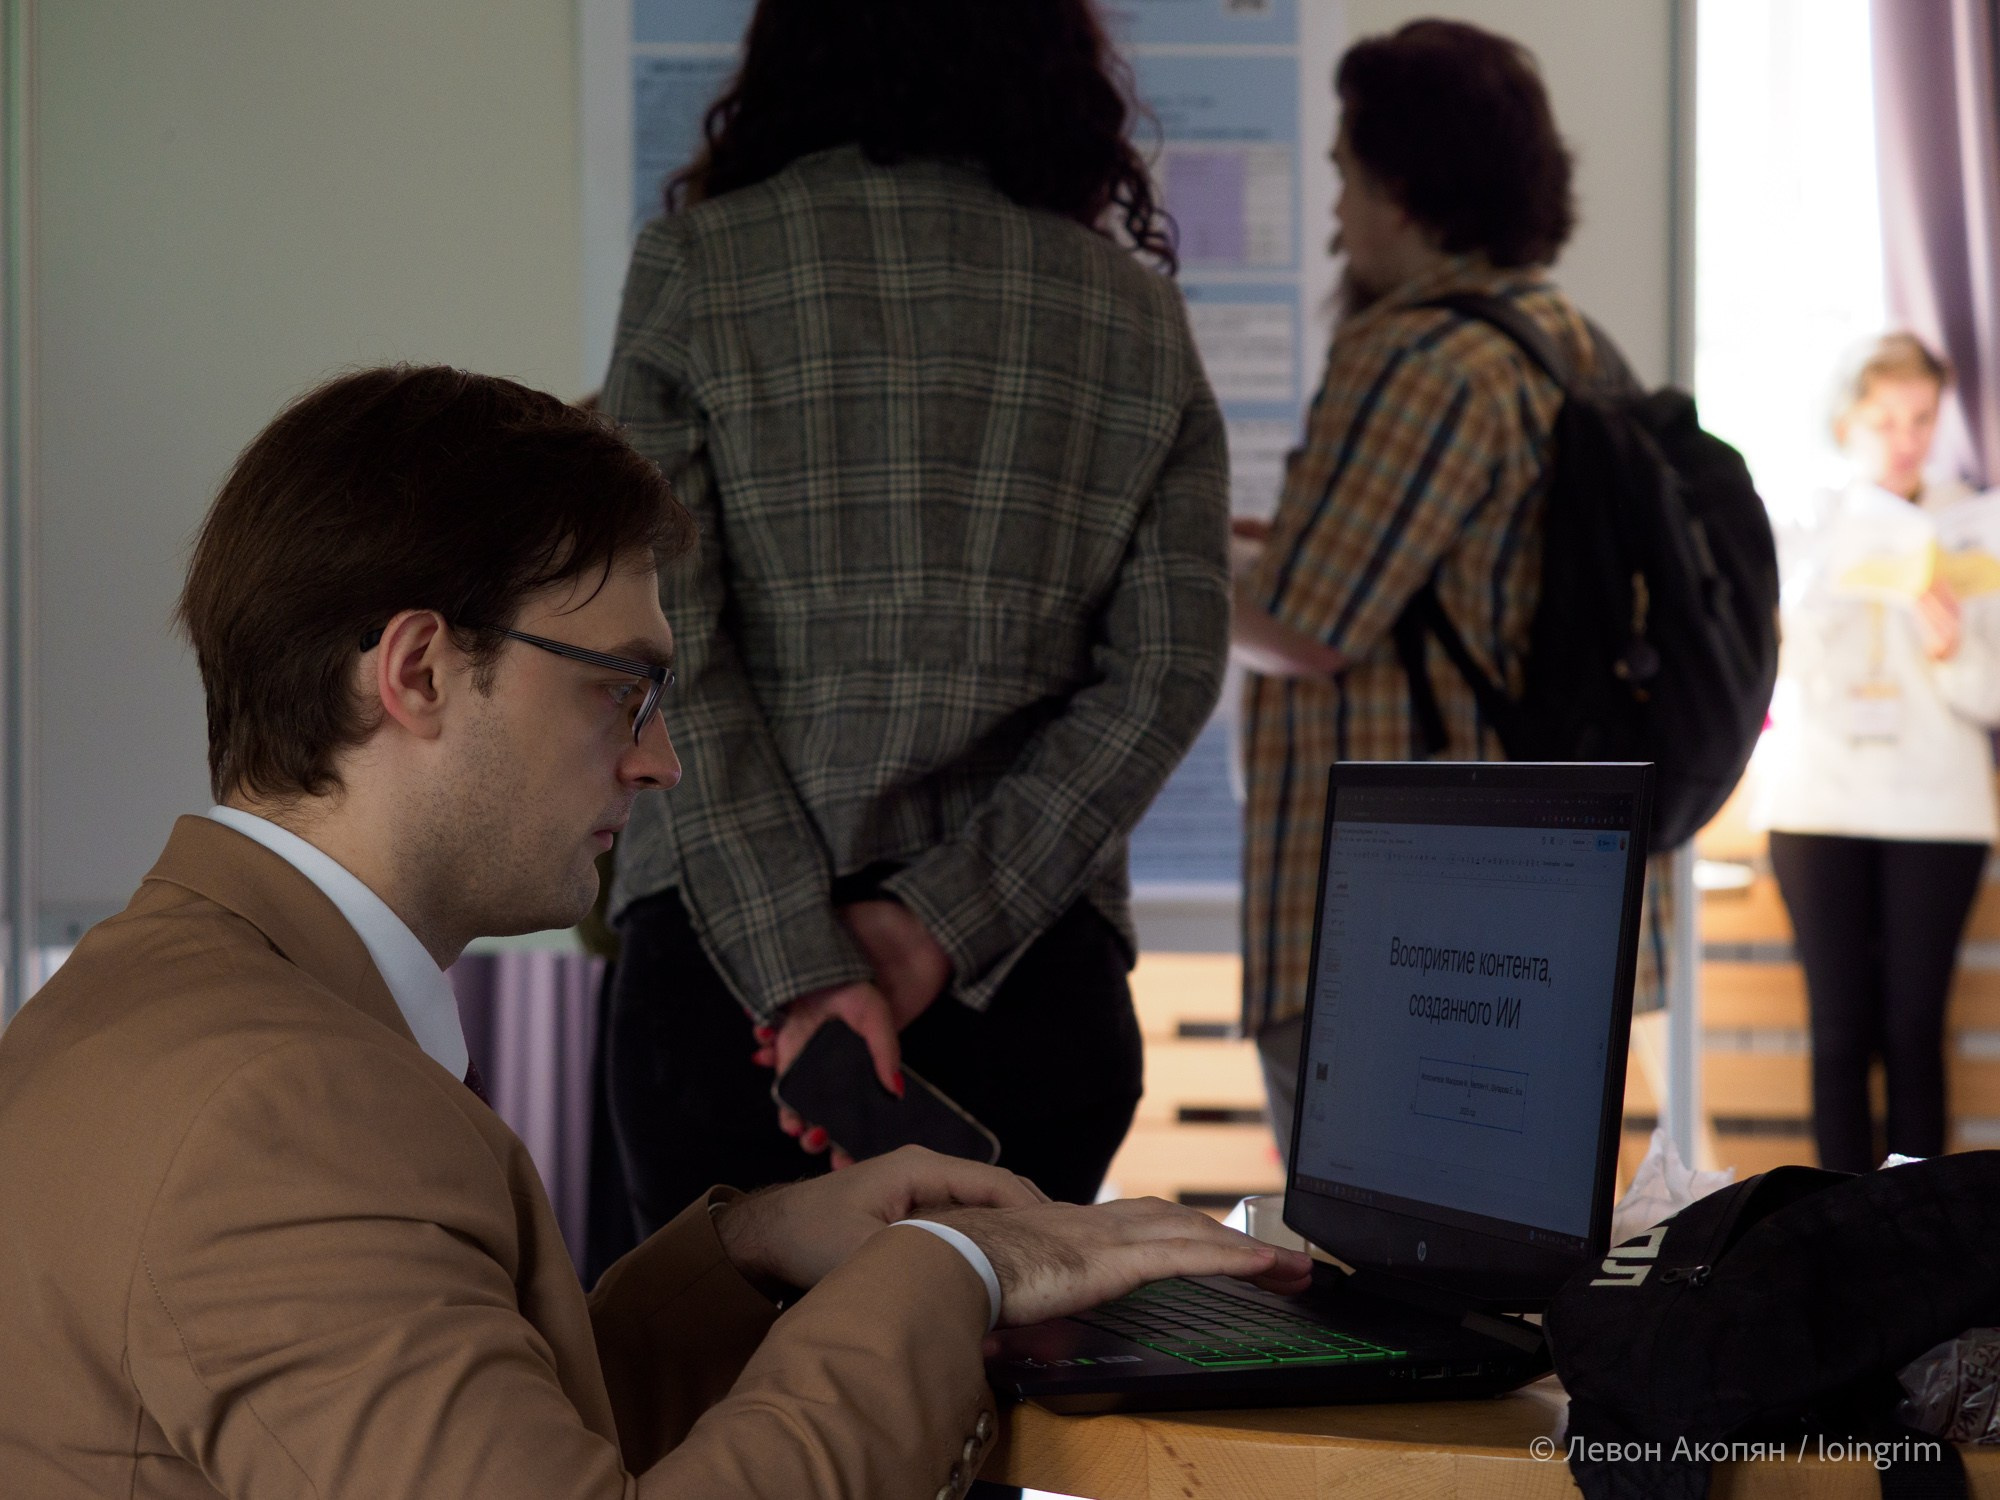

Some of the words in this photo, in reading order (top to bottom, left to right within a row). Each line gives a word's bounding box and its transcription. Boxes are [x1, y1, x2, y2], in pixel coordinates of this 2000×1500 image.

[1390, 935, 1475, 976] Восприятие
[1479, 952, 1552, 988] контента,
[1409, 993, 1492, 1025] созданного
[1496, 996, 1522, 1029] ИИ
